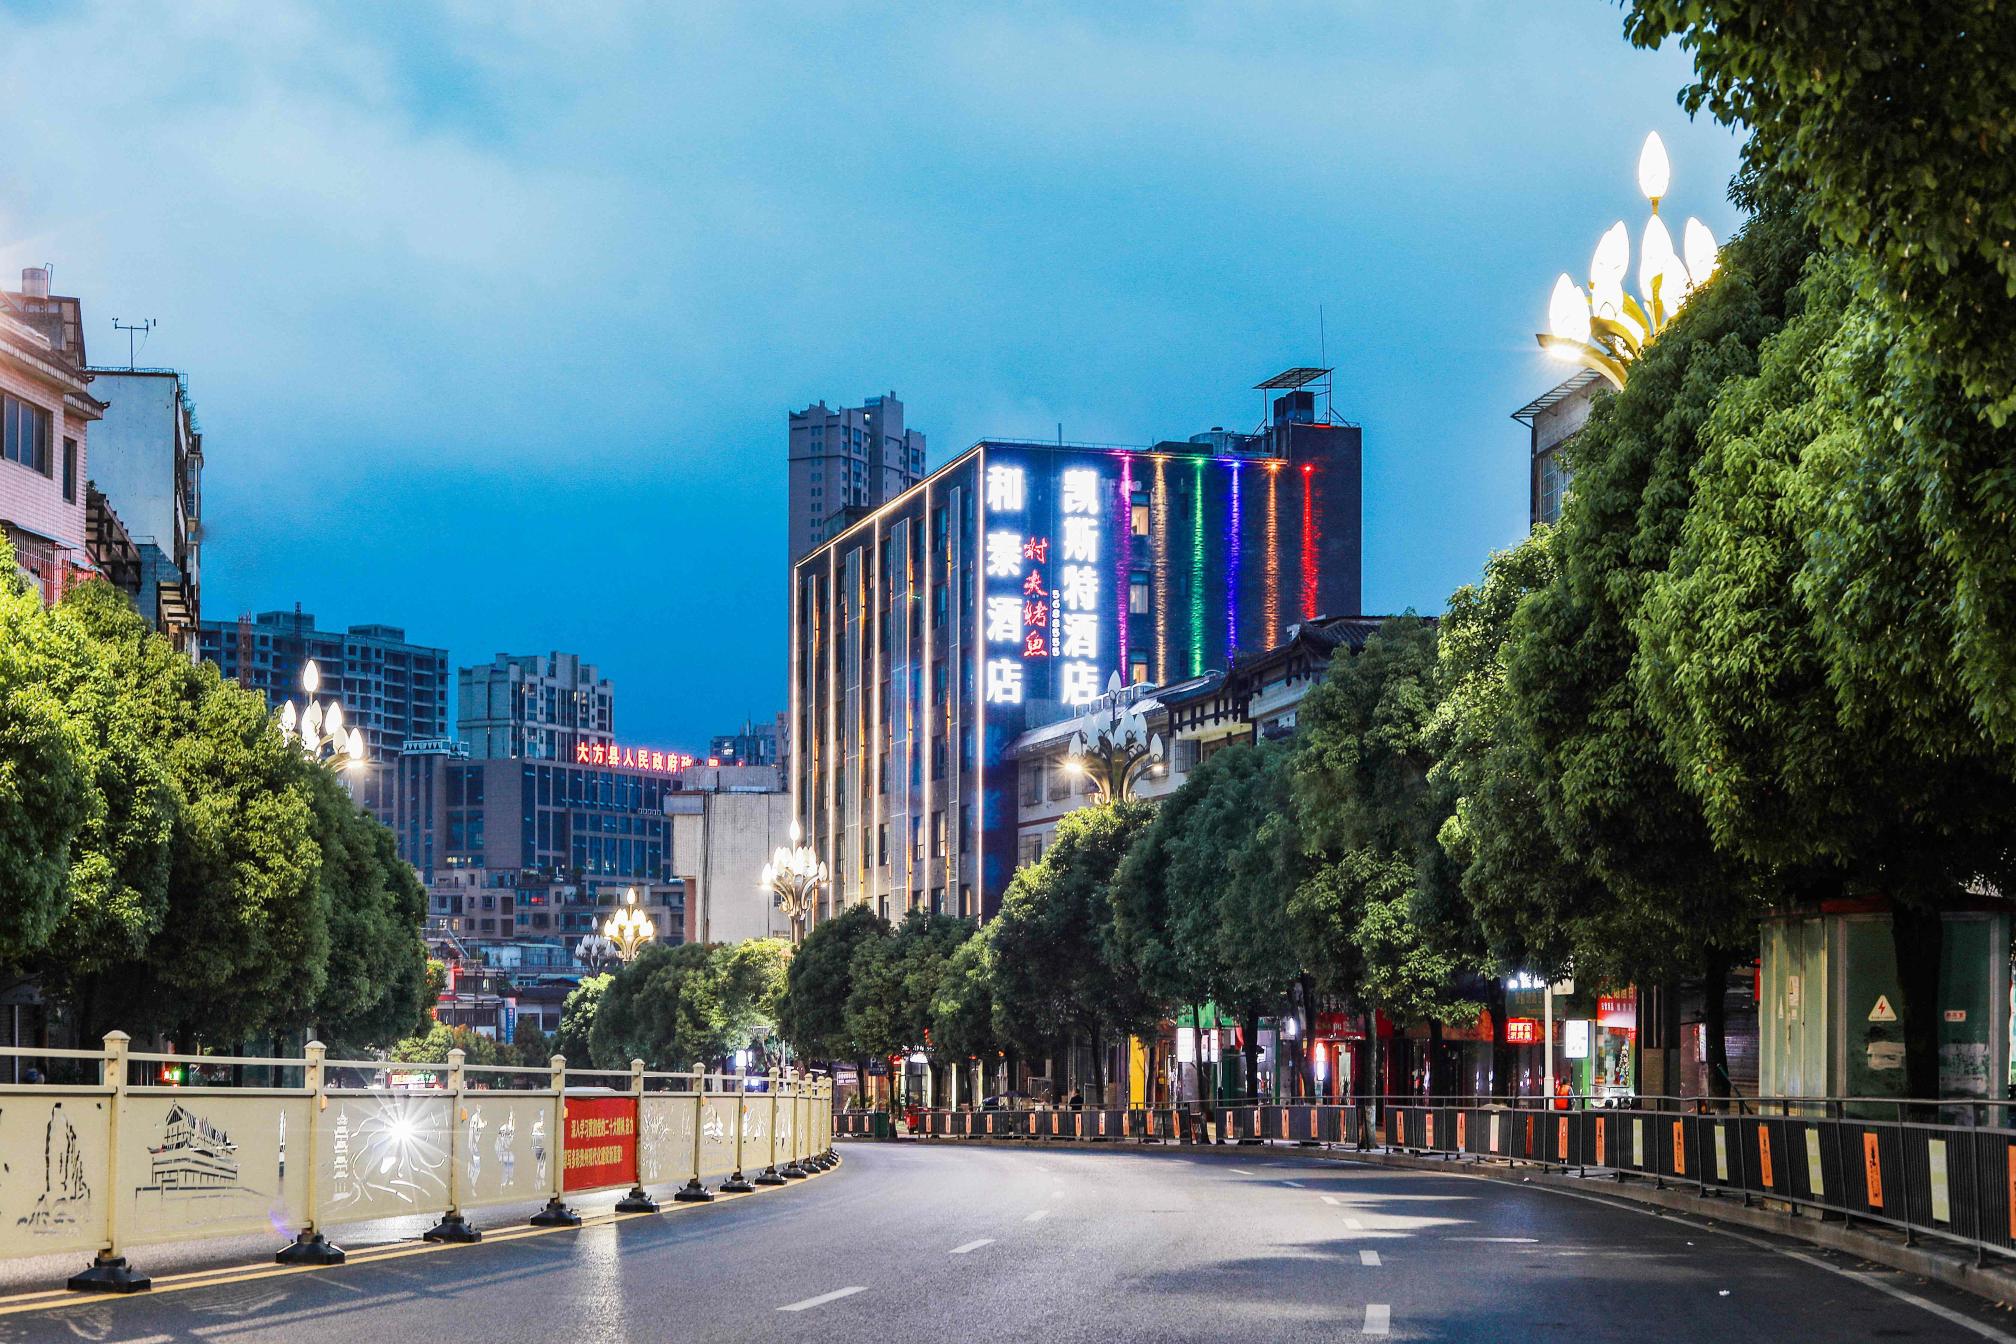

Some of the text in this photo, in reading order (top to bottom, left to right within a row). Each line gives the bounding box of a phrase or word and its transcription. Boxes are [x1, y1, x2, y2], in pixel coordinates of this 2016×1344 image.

[1062, 469, 1099, 704] 凯斯特酒店
